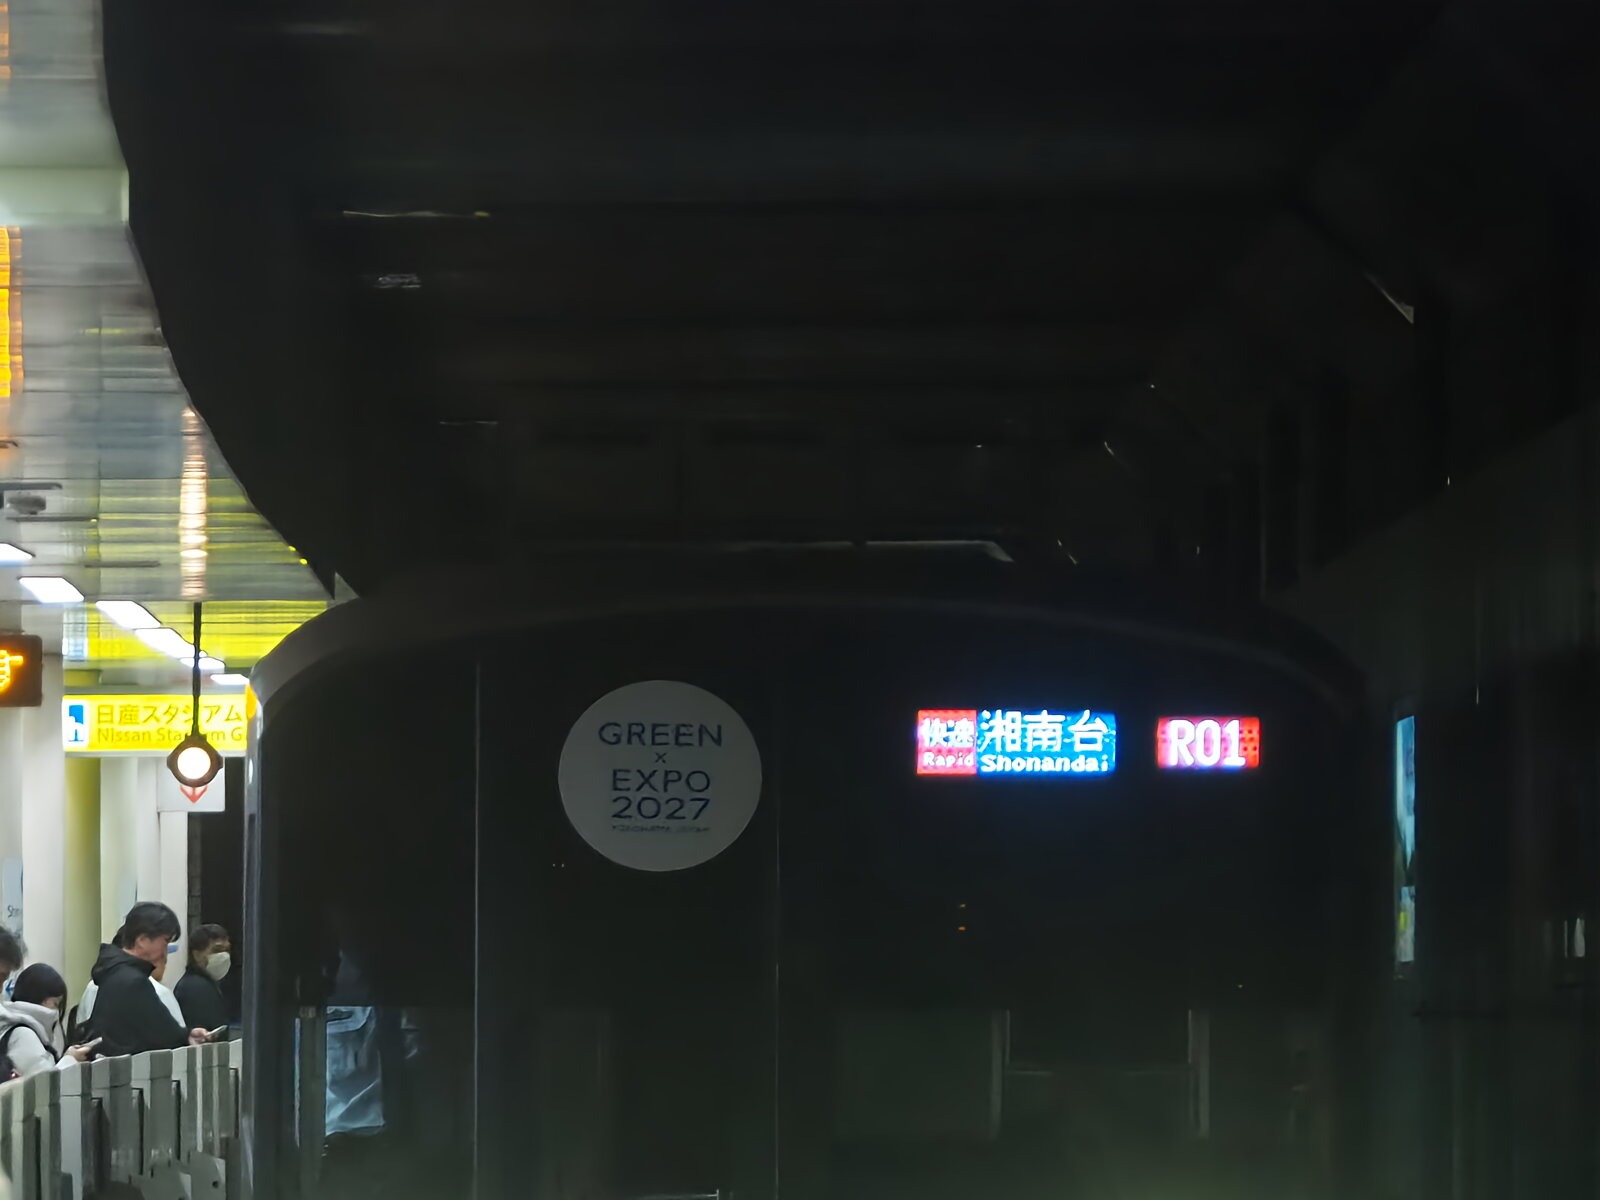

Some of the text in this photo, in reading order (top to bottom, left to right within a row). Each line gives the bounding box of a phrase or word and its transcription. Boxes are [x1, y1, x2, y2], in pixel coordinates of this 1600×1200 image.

[97, 727, 151, 742] Nissan
[157, 726, 226, 742] Stam
[598, 722, 722, 746] GREEN
[921, 709, 1112, 753] 快速 湘南台
[1167, 718, 1247, 767] R01
[922, 752, 1109, 773] Rapid Shonandai
[611, 769, 711, 793] EXPO
[611, 796, 711, 821] 2027
